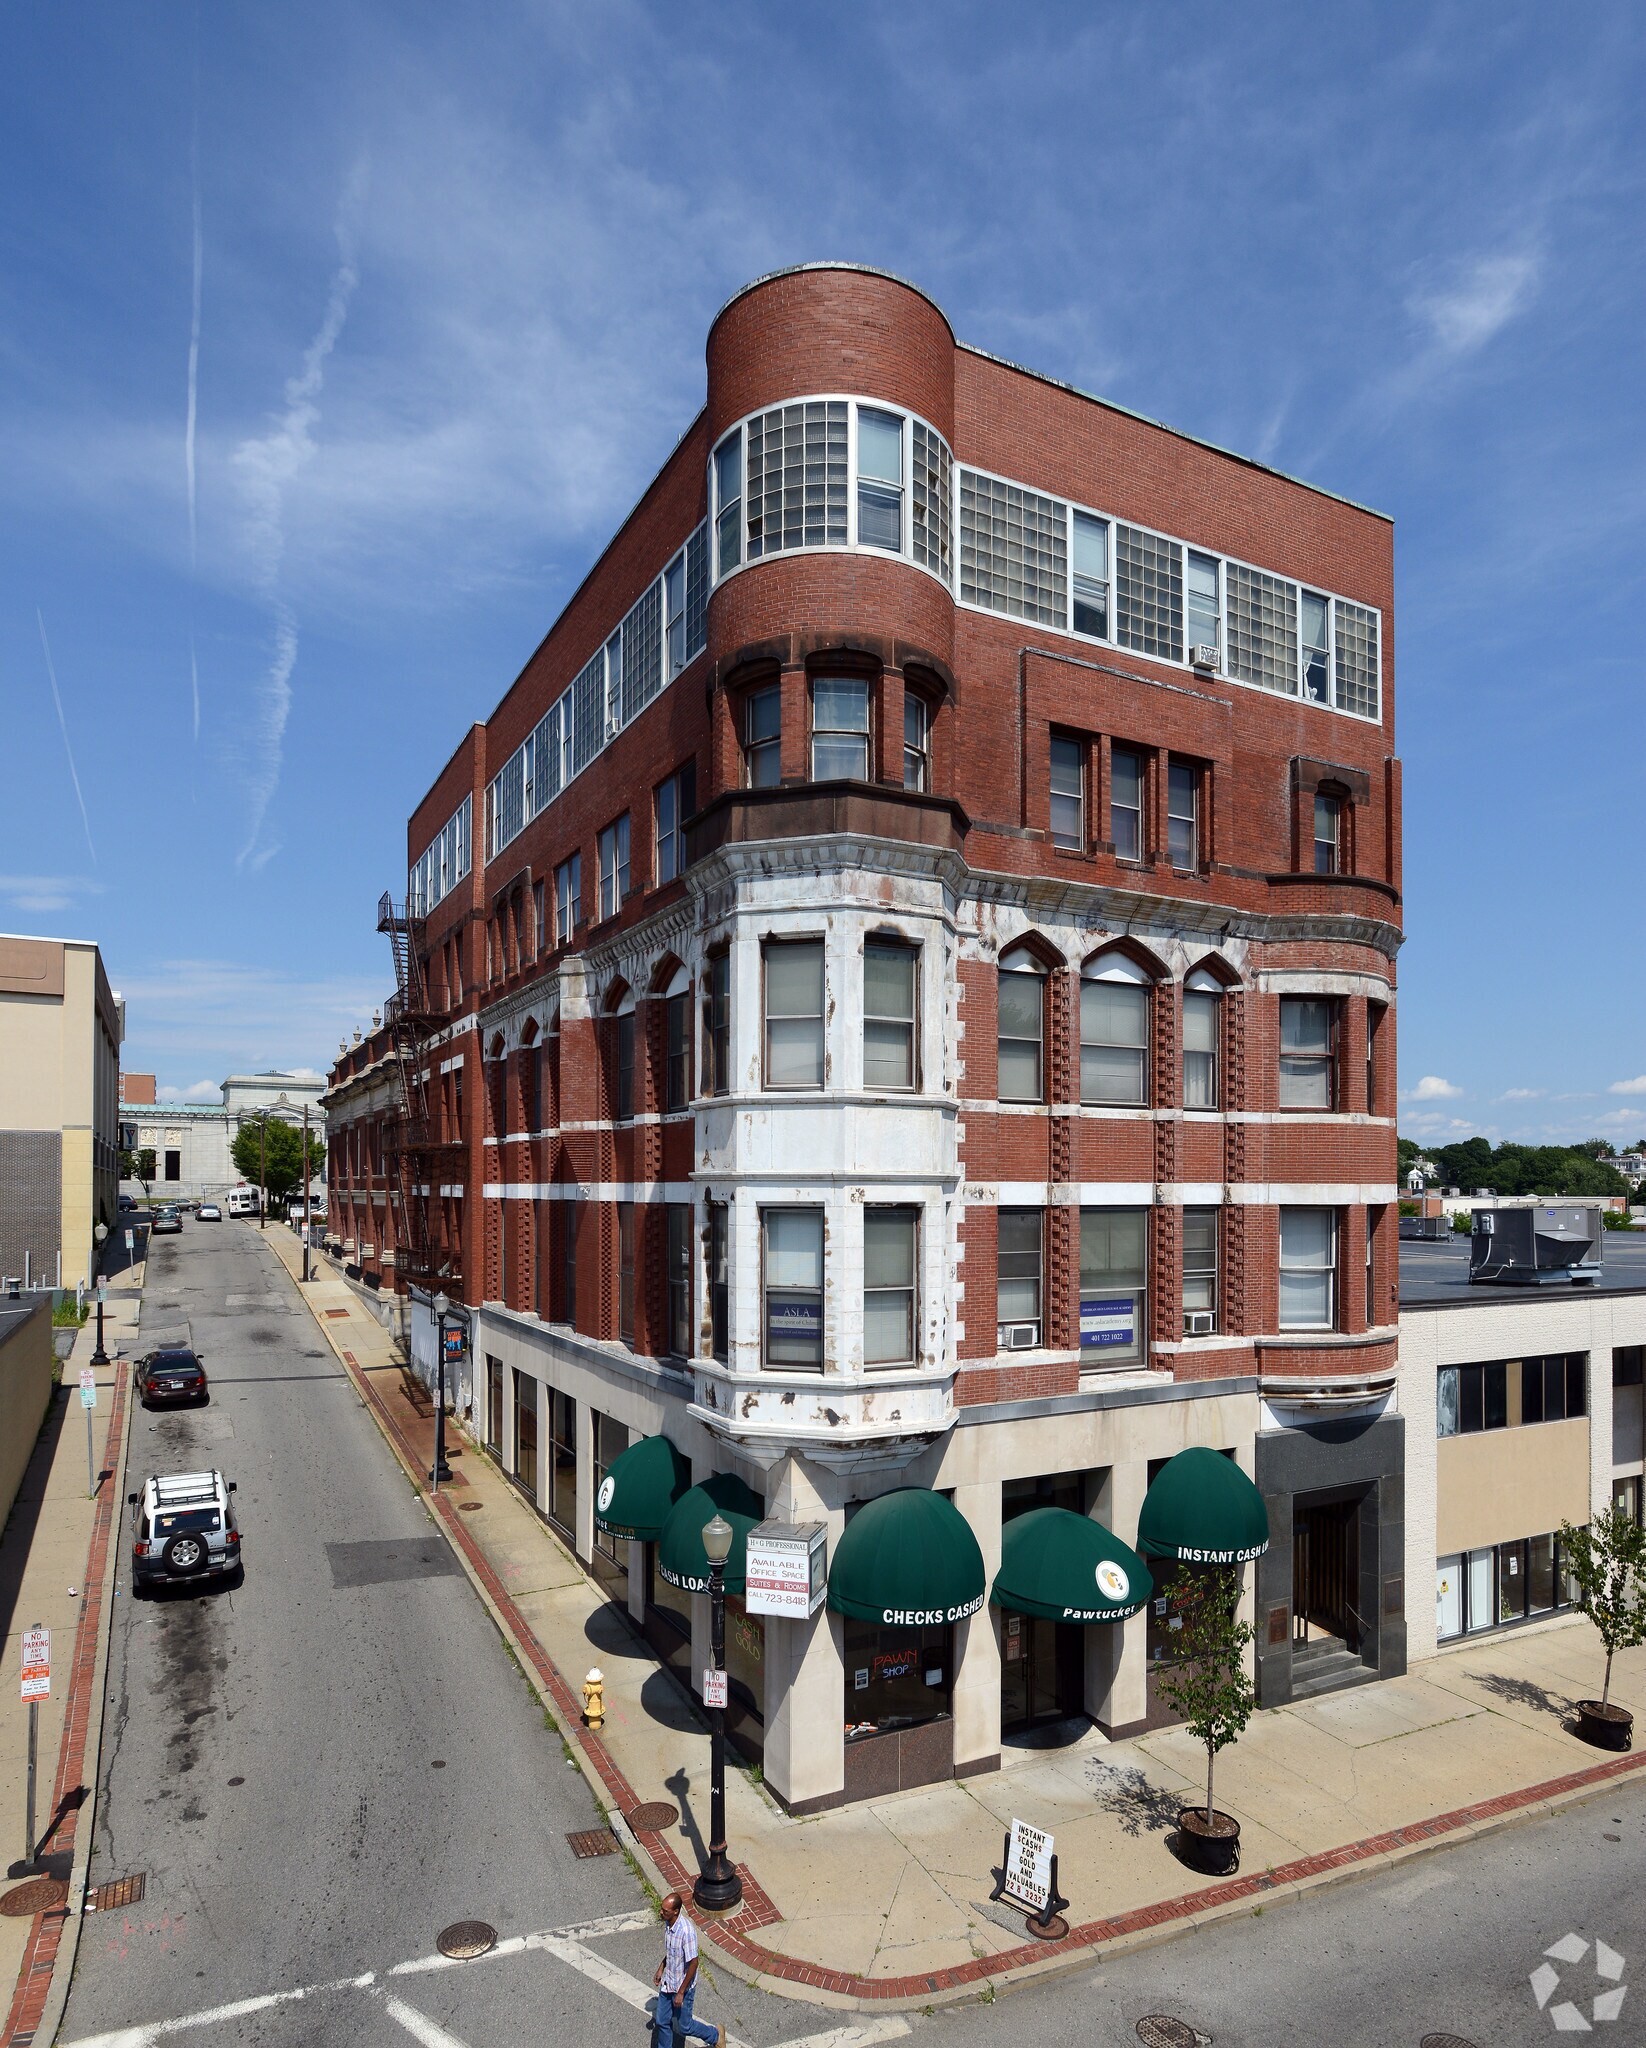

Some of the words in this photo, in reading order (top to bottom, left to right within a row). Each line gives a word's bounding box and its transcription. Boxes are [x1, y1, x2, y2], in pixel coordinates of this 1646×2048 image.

[783, 1307, 810, 1317] ASLA
[766, 1540, 807, 1551] PROFESSIONAL
[1177, 1546, 1234, 1563] INSTANT
[1237, 1546, 1261, 1561] CASH
[751, 1558, 804, 1570] AVAILABLE
[660, 1564, 679, 1586] CASH
[750, 1568, 777, 1577] OFFICE
[782, 1570, 805, 1579] SPACE
[749, 1579, 771, 1588] SUITES
[784, 1583, 806, 1591] ROOMS
[764, 1593, 807, 1606] 723-8418
[883, 1609, 944, 1625] CHECKS
[947, 1594, 984, 1621] CASHED
[1063, 1605, 1135, 1619] Pawtucket
[735, 1613, 760, 1641] CASH
[24, 1640, 49, 1649] PARKING
[736, 1632, 760, 1661] GOLD
[873, 1649, 918, 1673] PAWN
[882, 1664, 909, 1679] SHOP
[705, 1680, 725, 1690] PARKING
[1018, 1825, 1046, 1844] INSTANT
[1022, 1847, 1035, 1860] FOR
[1019, 1857, 1035, 1870] GOLD
[1020, 1867, 1033, 1878] AND
[1008, 1870, 1046, 1896] VALUABLES
[1006, 1879, 1014, 1890] 72
[1025, 1889, 1042, 1904] 3232
